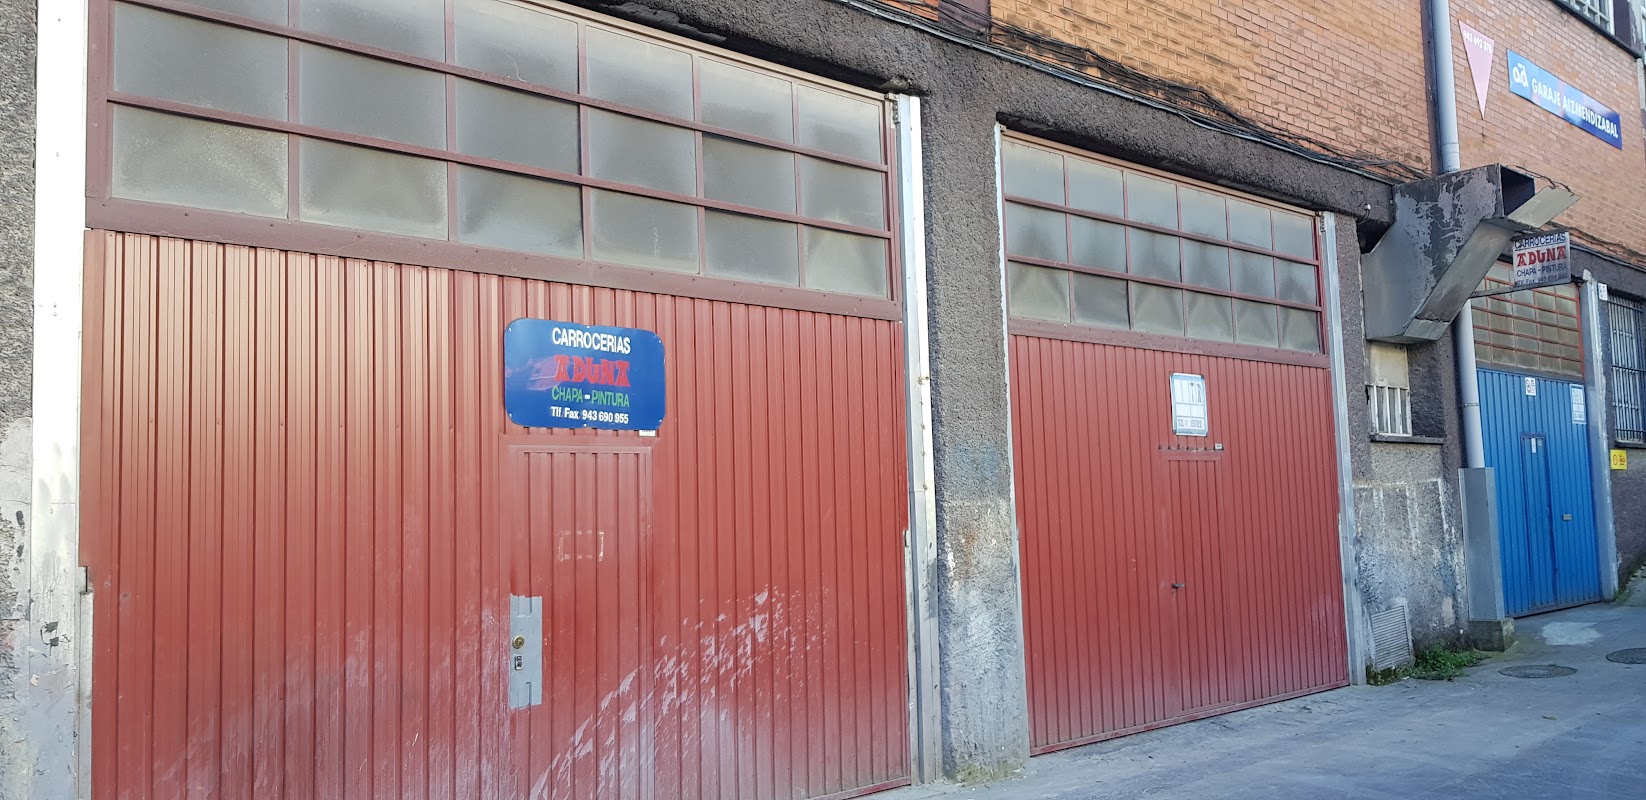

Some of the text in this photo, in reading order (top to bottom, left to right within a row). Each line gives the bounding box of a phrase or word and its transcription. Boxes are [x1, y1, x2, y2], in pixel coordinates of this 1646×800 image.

[1531, 78, 1561, 106] GARAJE
[1562, 95, 1619, 139] AIZMENDIZABAL
[1515, 232, 1566, 249] CARROCERIAS
[1517, 246, 1567, 267] ADUNA
[1517, 267, 1537, 277] CHAPA
[1541, 262, 1568, 273] PINTURA
[552, 327, 631, 354] CARROCERIAS
[554, 354, 631, 387] ADUNA
[552, 386, 583, 403] CHAPA
[592, 390, 630, 407] PINTURA
[582, 410, 598, 421] 943
[599, 411, 614, 422] 690
[614, 412, 629, 424] 955
